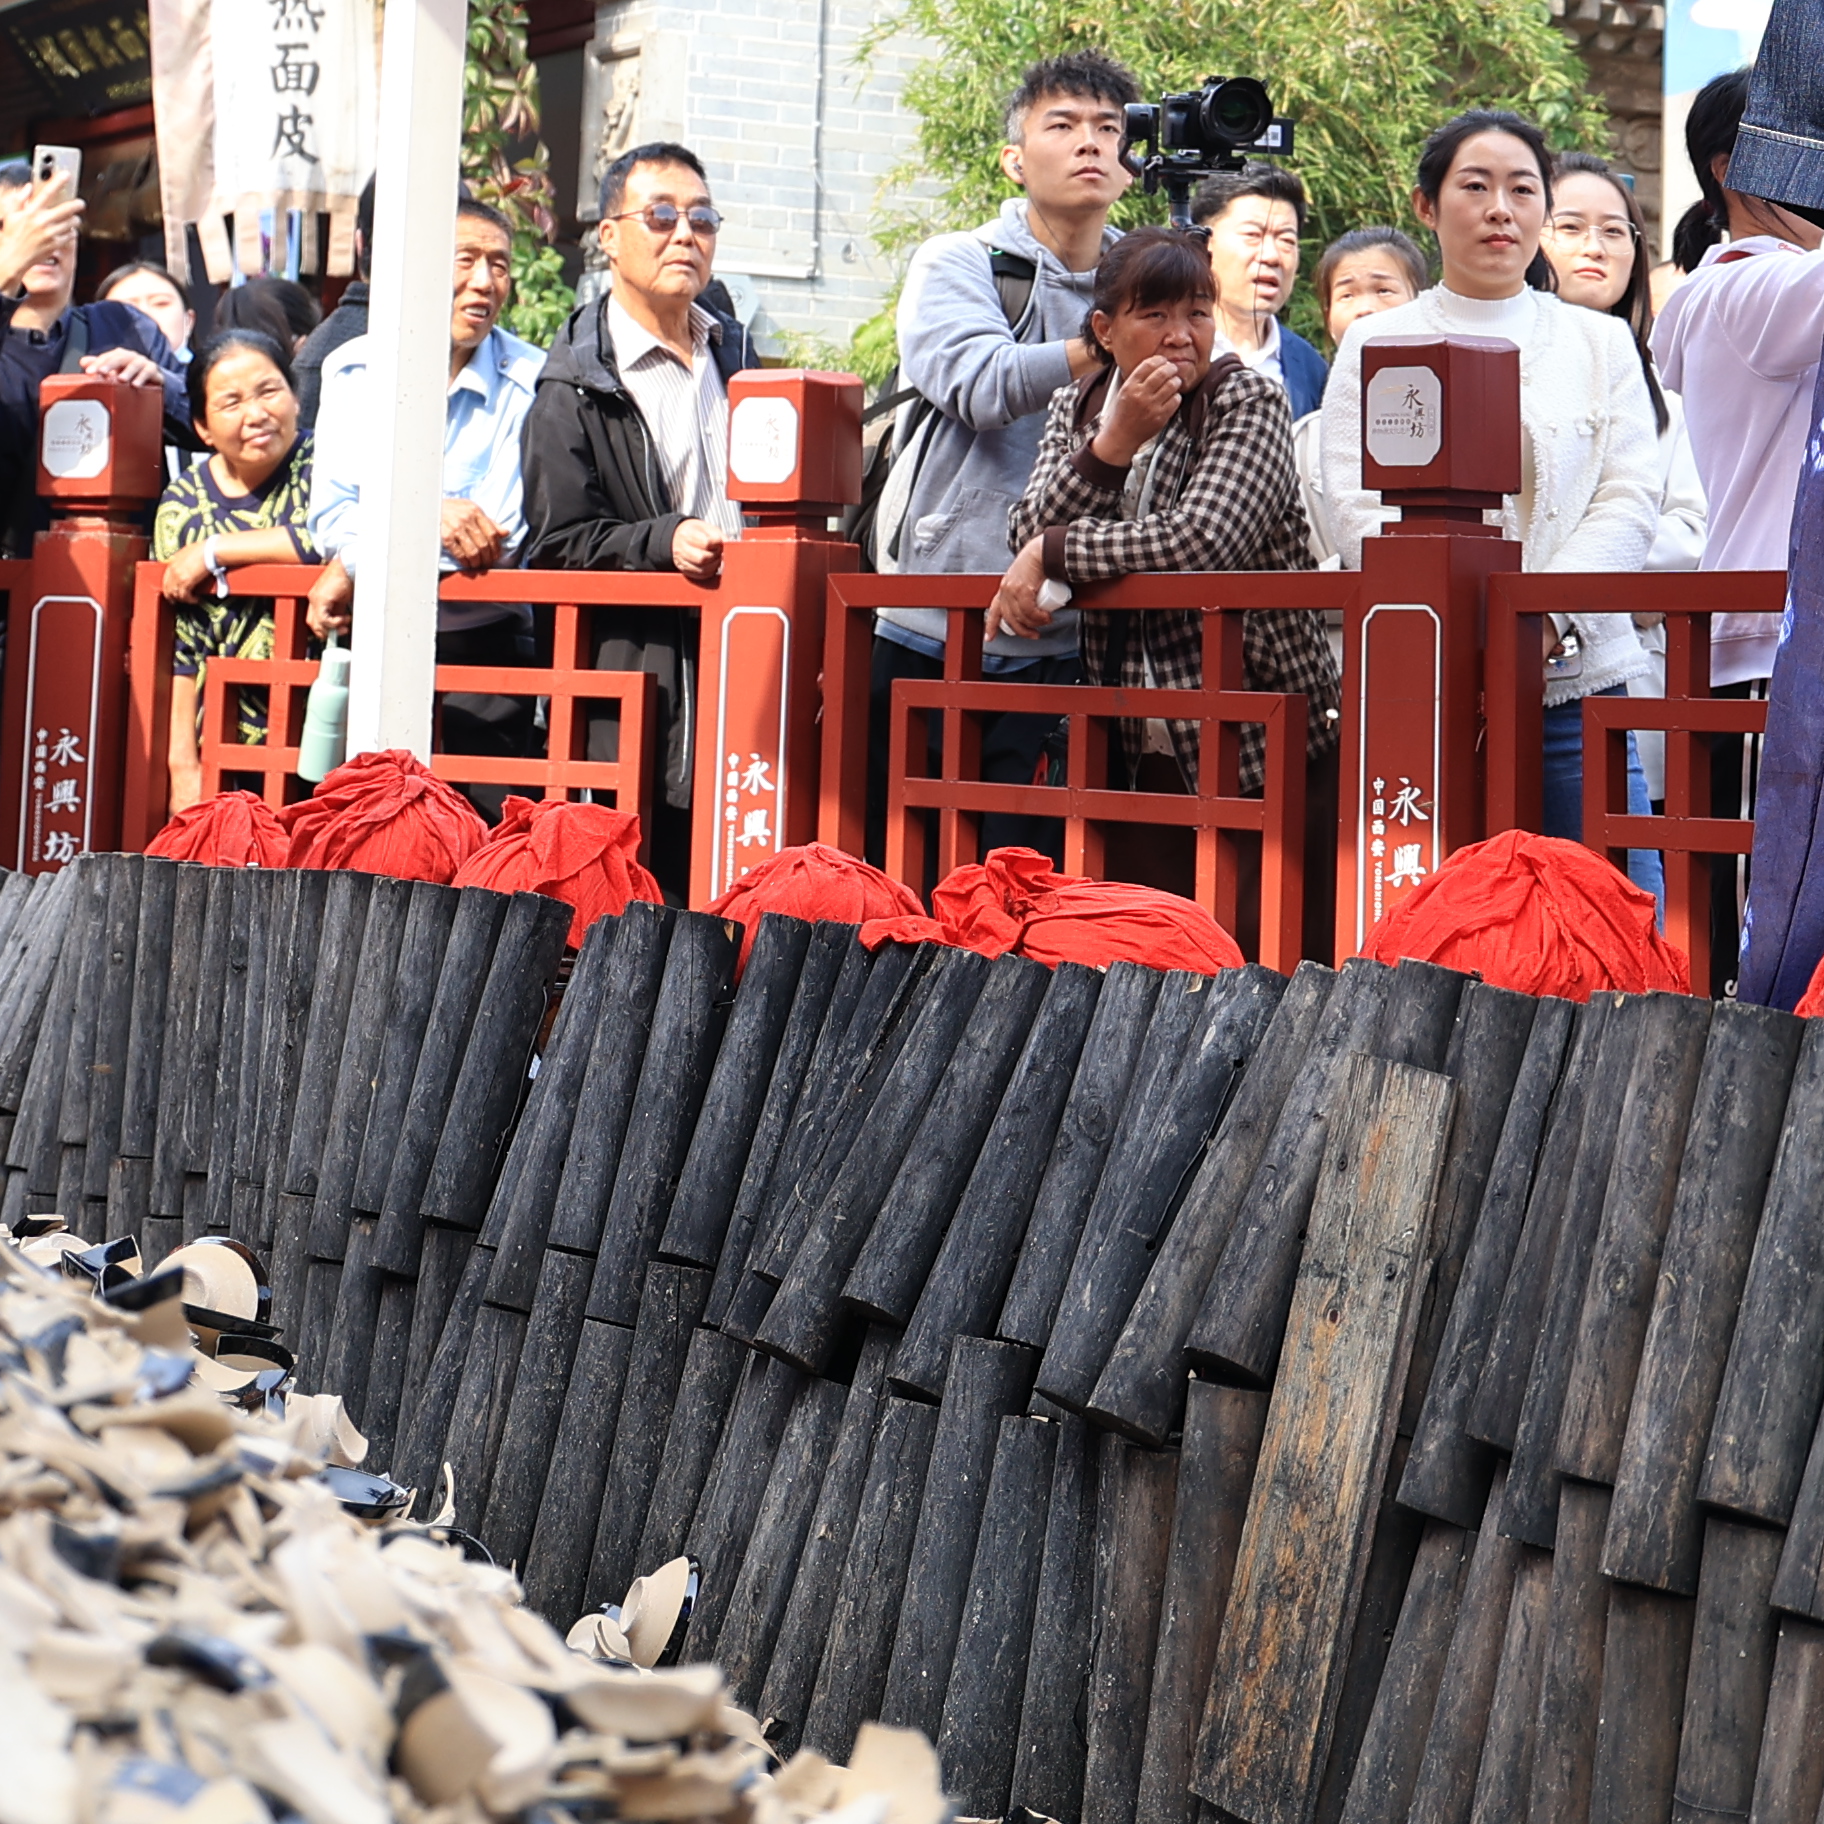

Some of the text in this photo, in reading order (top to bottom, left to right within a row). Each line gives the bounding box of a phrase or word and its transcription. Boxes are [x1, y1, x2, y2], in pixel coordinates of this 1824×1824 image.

[43, 727, 86, 864] 永興坊
[735, 752, 776, 876] 永興
[1371, 776, 1386, 857] 中国西安
